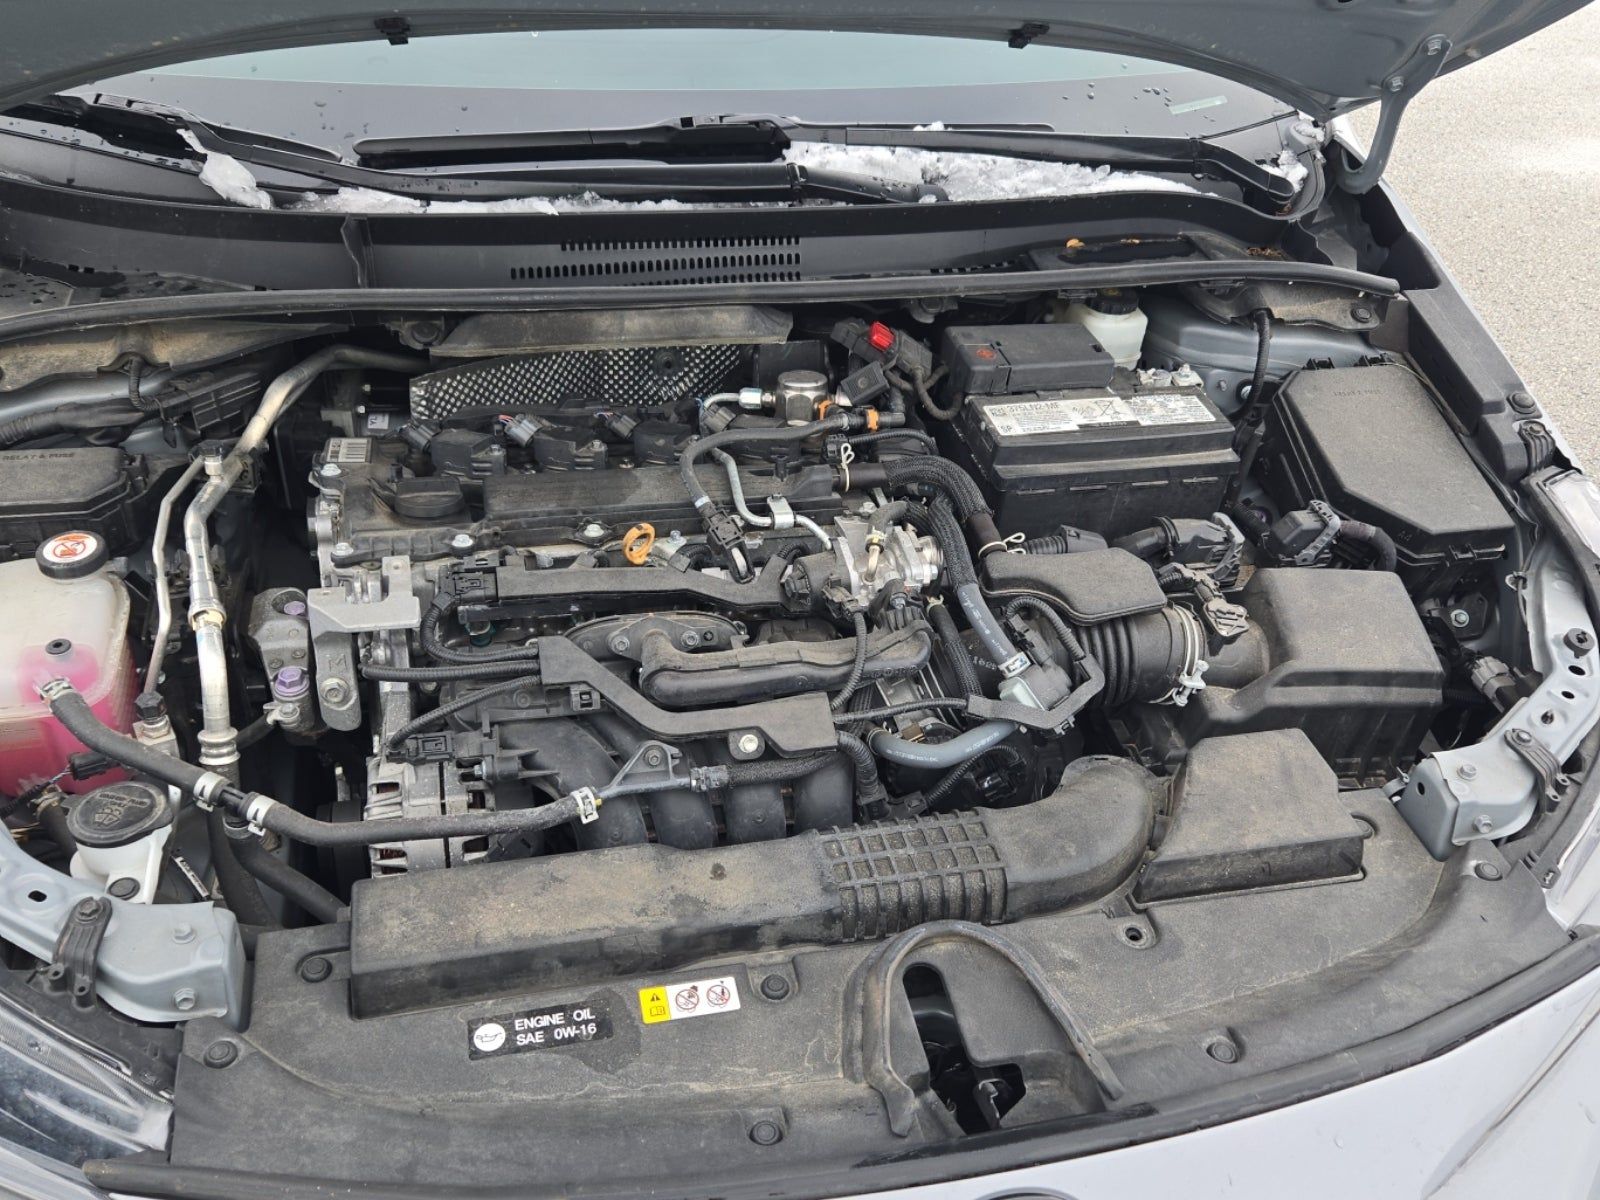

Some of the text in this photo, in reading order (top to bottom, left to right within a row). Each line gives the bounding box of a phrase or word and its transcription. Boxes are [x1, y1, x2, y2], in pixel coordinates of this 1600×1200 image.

[515, 1008, 596, 1031] ENGINE OIL
[516, 1023, 597, 1046] SAE 0W-16
